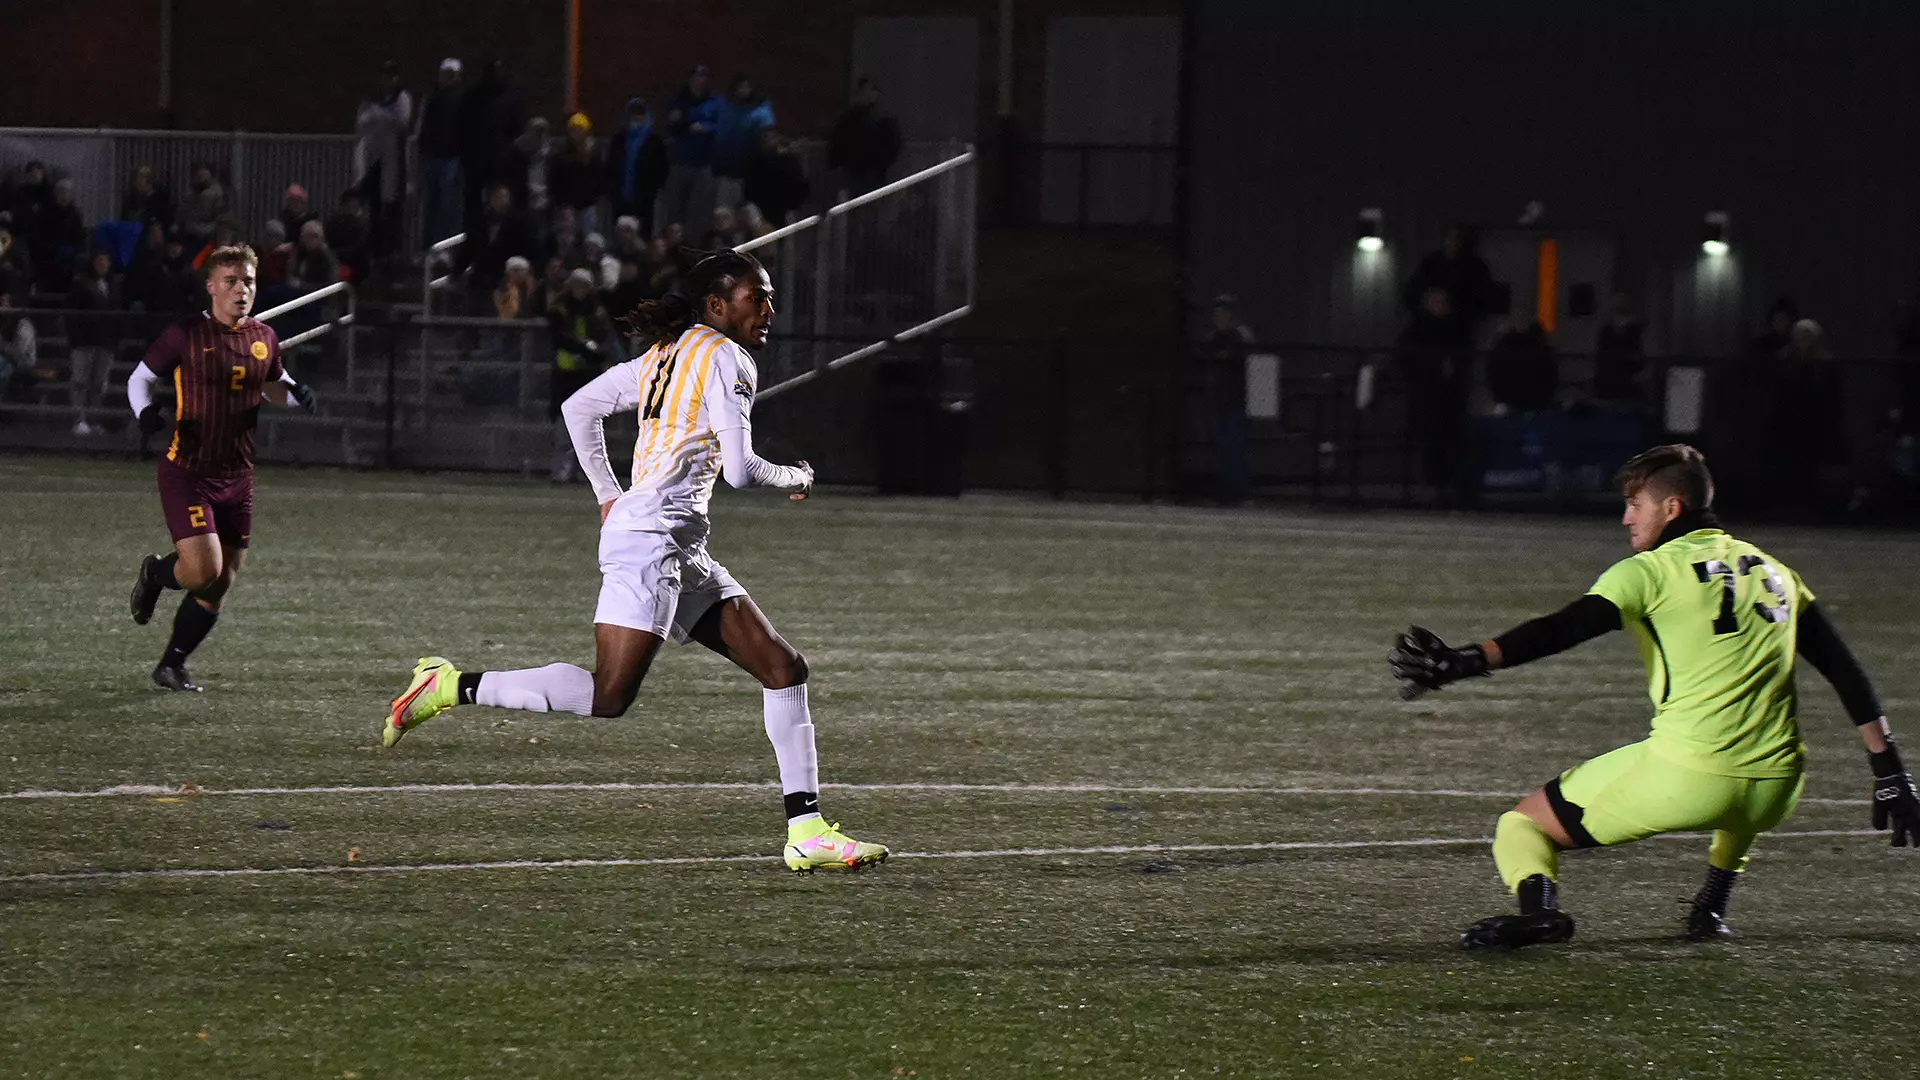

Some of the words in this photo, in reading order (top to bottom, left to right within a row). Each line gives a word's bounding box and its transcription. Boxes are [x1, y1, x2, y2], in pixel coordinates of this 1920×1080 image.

[231, 365, 246, 390] 2
[642, 348, 680, 420] 11
[188, 505, 207, 528] 2
[1691, 554, 1790, 635] 73
